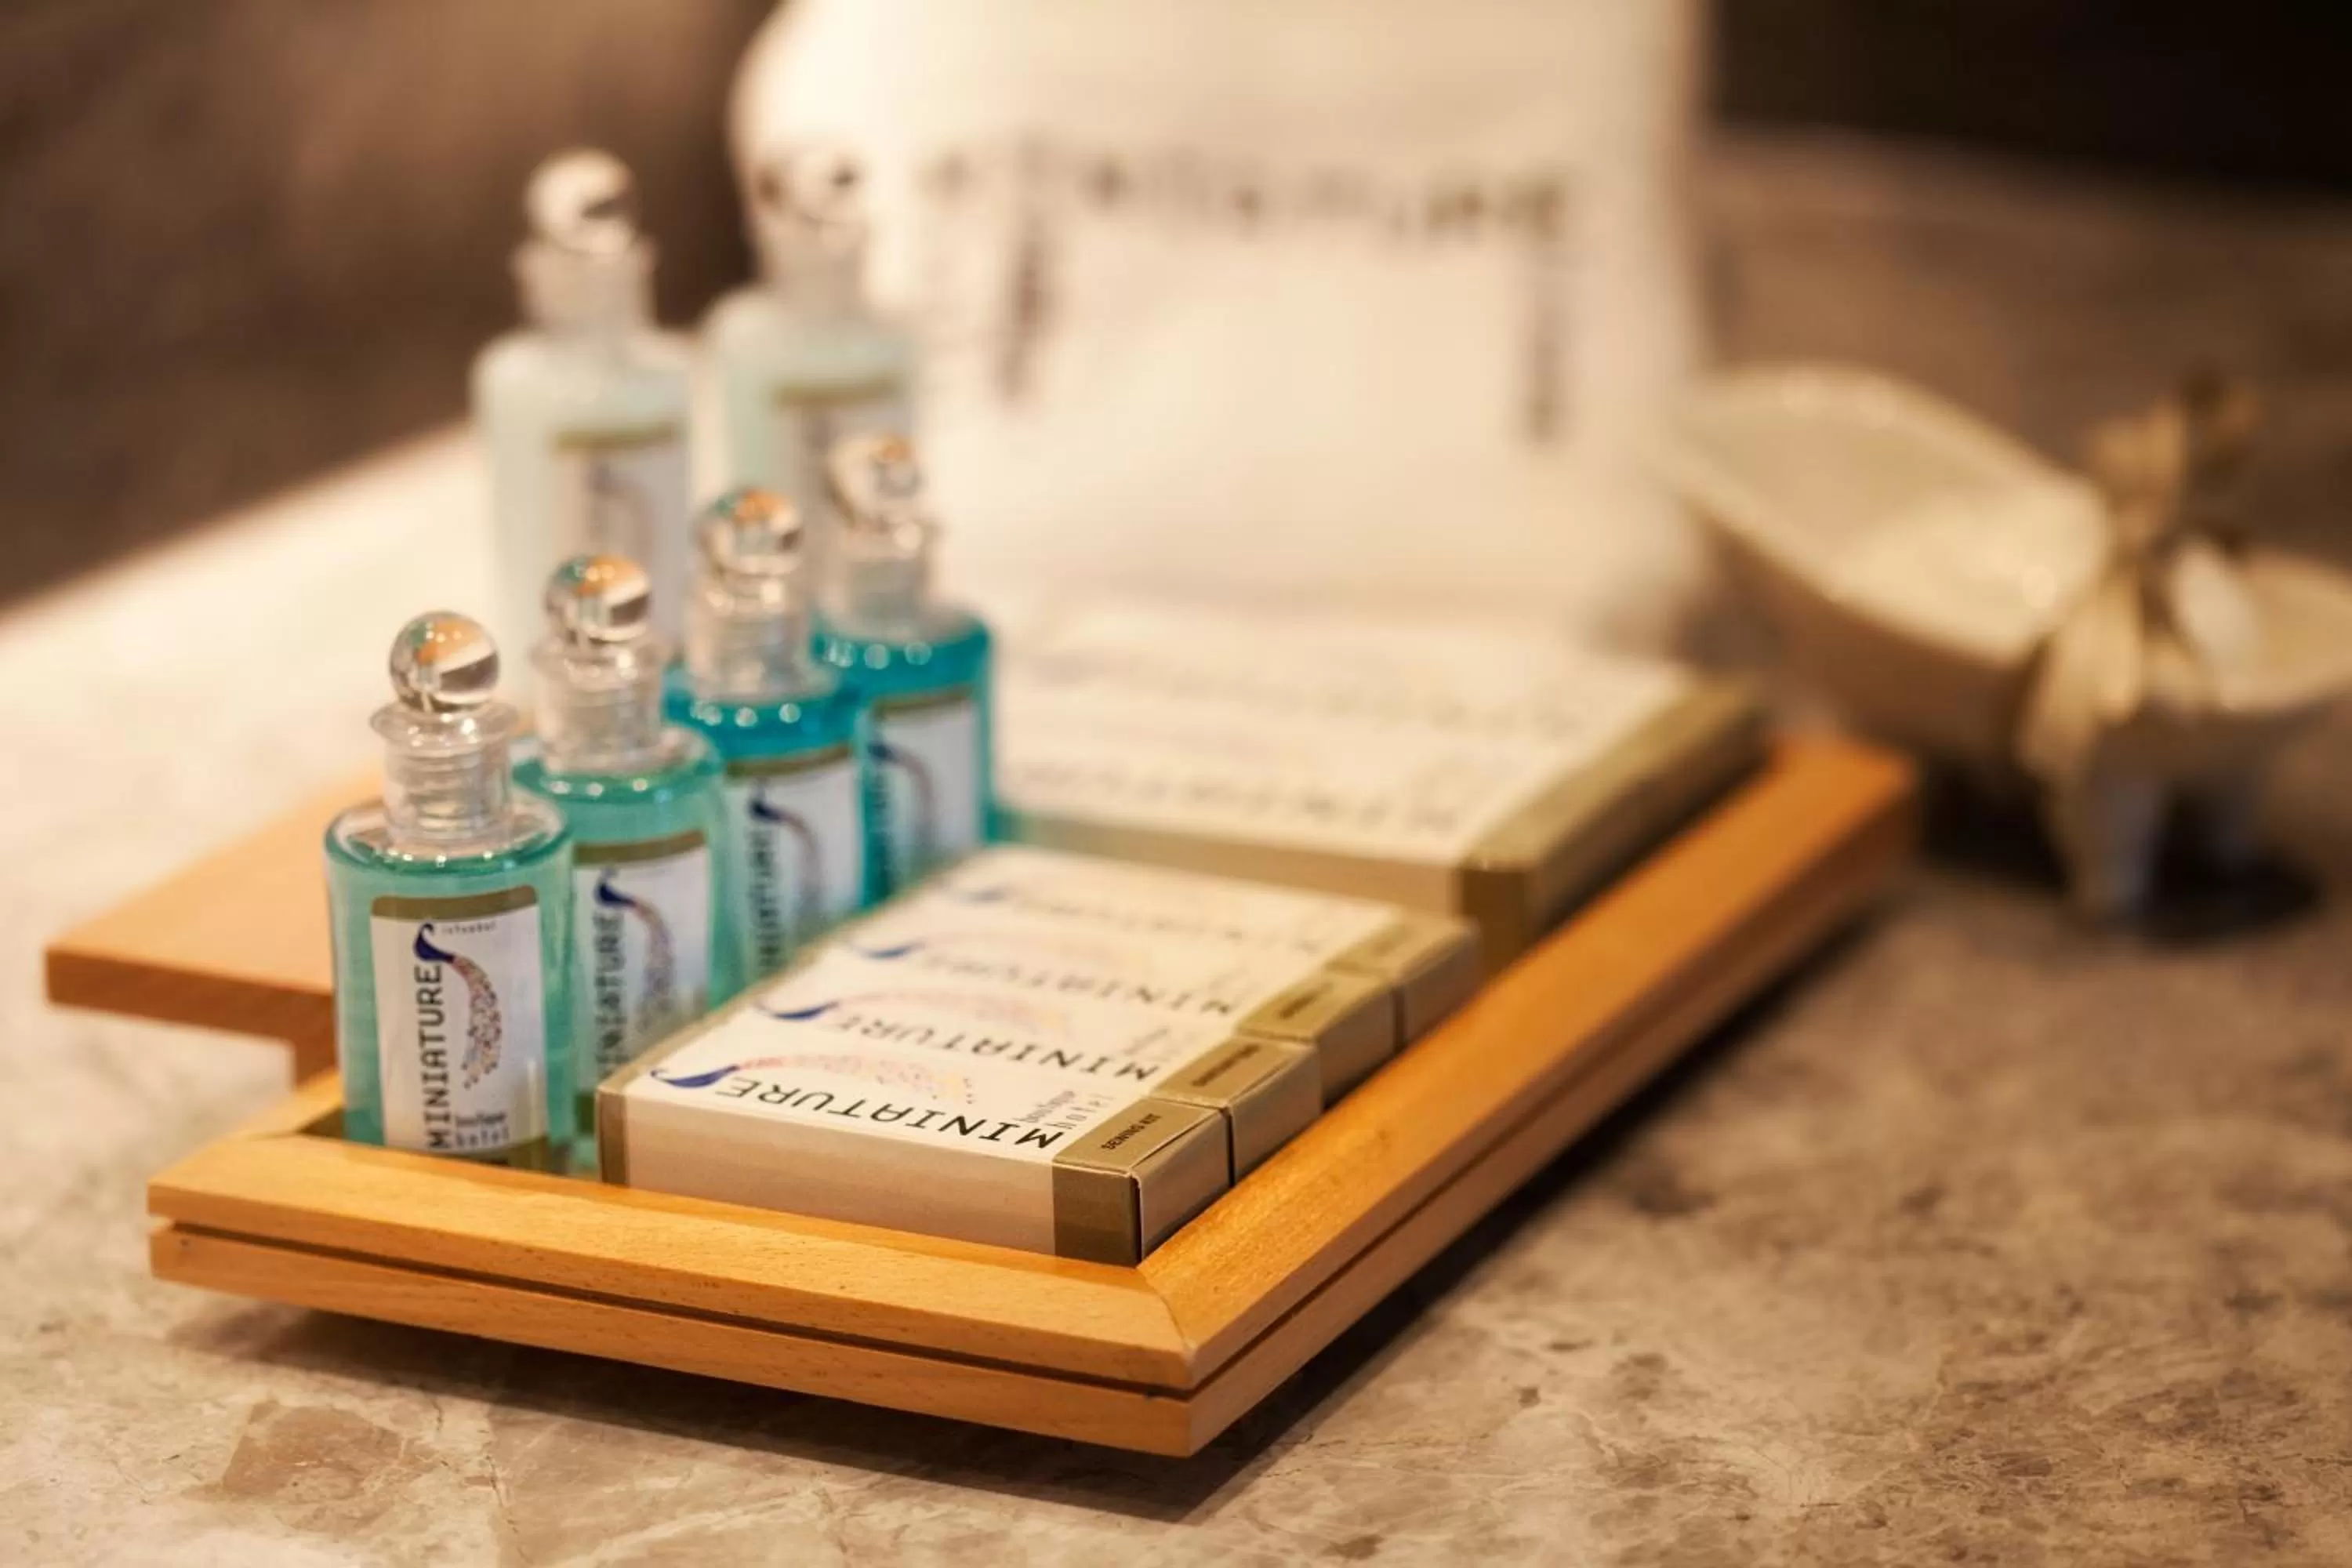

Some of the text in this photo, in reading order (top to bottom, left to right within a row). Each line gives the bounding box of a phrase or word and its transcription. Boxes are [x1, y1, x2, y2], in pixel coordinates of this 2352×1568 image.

[413, 965, 452, 1149] MINIATURE
[837, 1017, 1160, 1080] MINIATURE
[713, 1076, 1065, 1149] MINIATURE
[1101, 1122, 1145, 1151] SEWING
